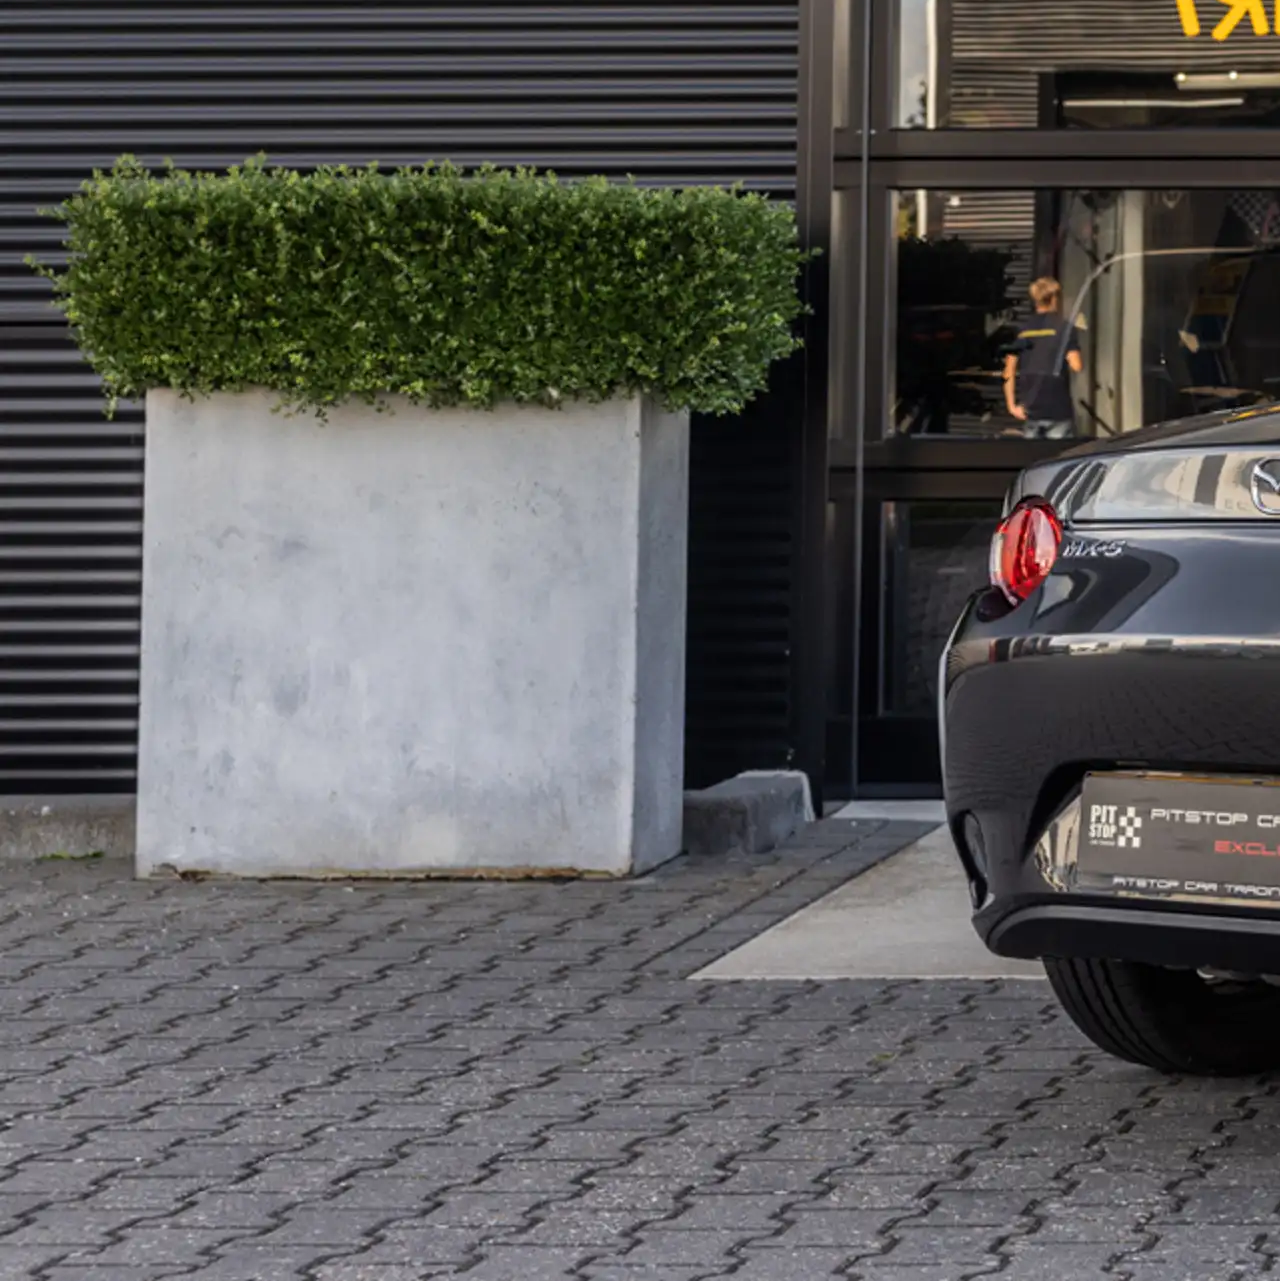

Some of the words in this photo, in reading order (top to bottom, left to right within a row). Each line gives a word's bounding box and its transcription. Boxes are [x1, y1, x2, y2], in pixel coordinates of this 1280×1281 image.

[1090, 804, 1118, 824] PIT
[1150, 808, 1248, 825] PITSTOP
[1088, 823, 1117, 838] STOP
[1112, 876, 1179, 889] PITSTOP
[1184, 880, 1218, 892] CAR
